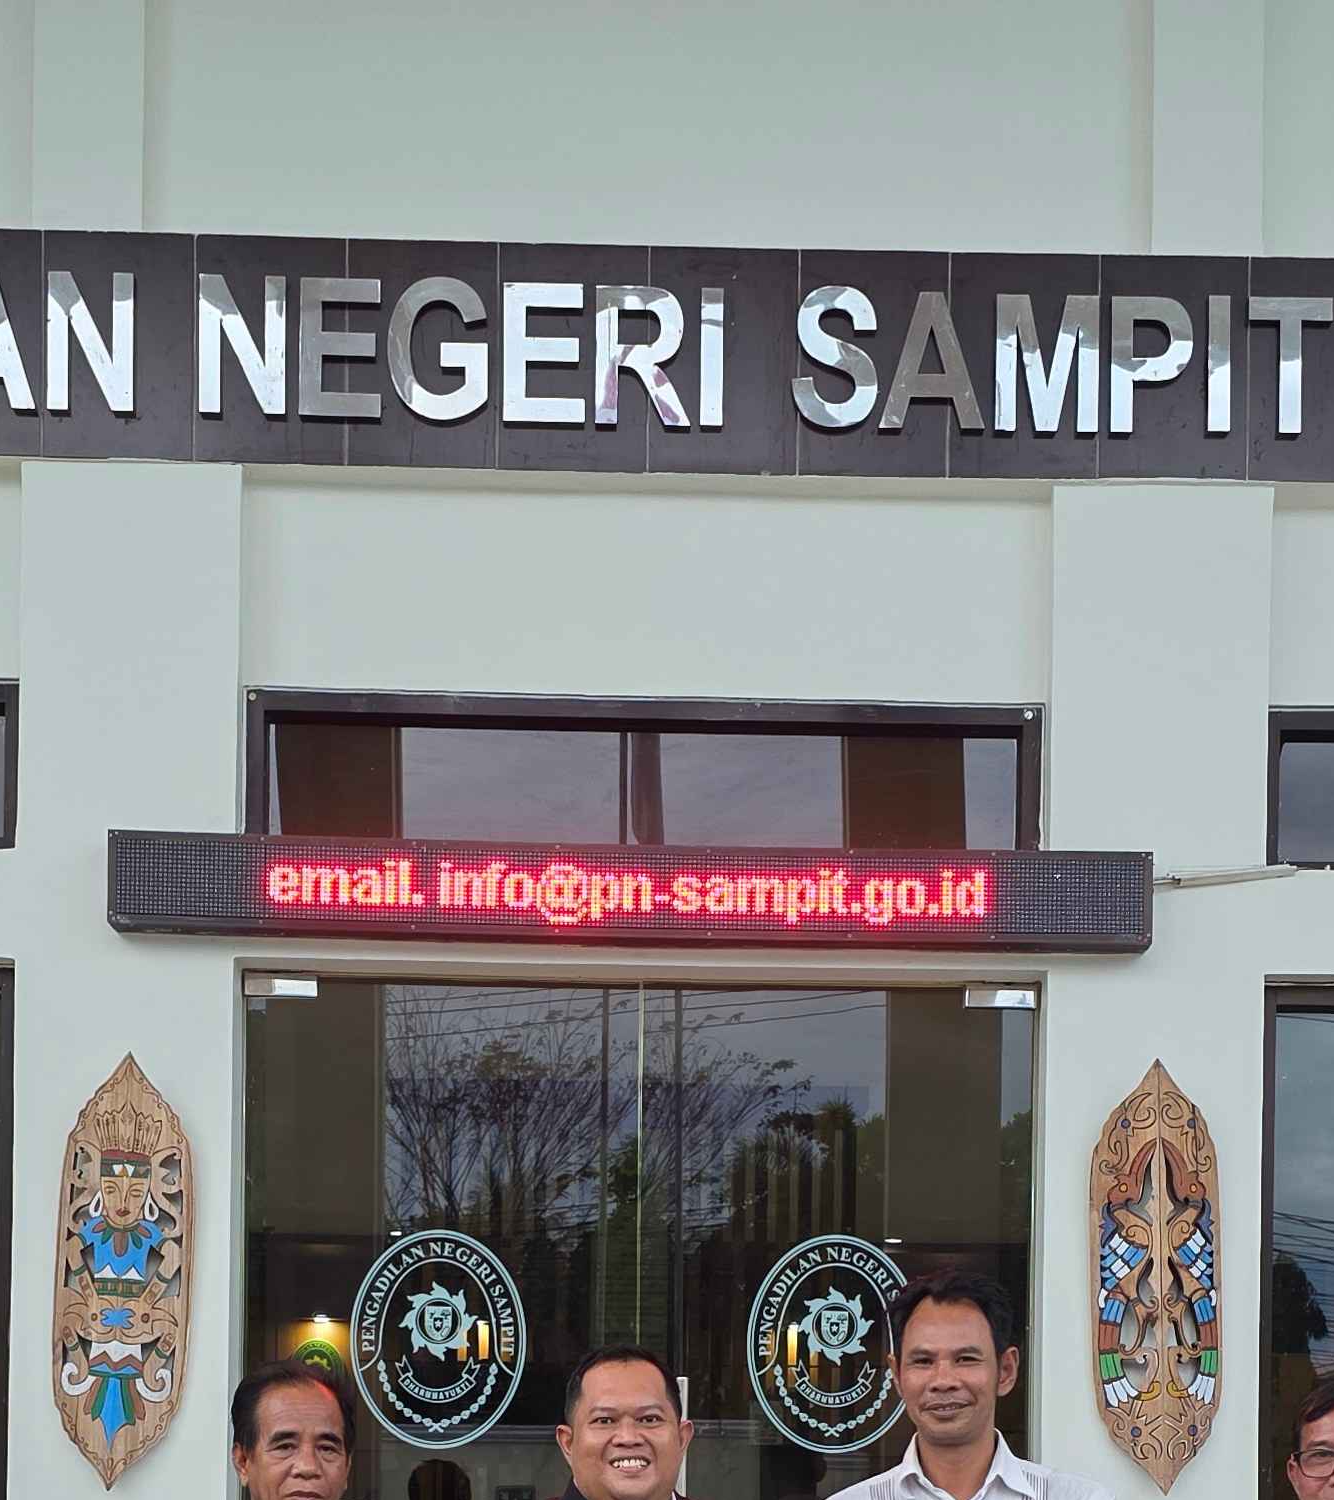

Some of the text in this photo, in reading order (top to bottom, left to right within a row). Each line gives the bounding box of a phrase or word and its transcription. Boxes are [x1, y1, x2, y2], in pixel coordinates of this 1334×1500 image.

[197, 273, 724, 428] NEGERI
[791, 283, 1334, 434] SAMPIT
[268, 859, 989, 926] email. info@pn-sampit.go.id
[362, 1241, 516, 1357] PENGADILAN NEGERI SAMPIT
[758, 1246, 894, 1358] PENGADILAN NEGERI
